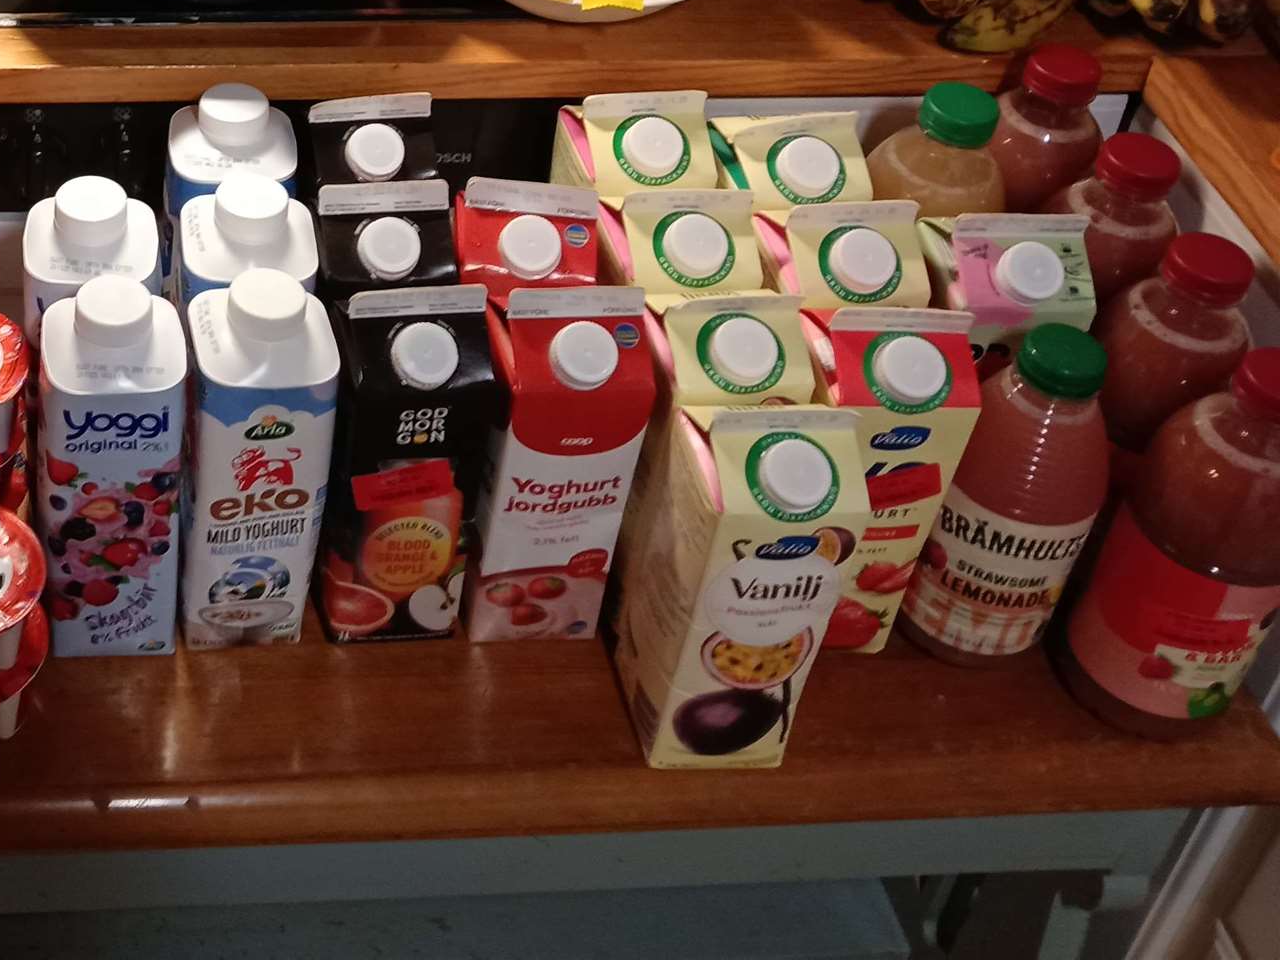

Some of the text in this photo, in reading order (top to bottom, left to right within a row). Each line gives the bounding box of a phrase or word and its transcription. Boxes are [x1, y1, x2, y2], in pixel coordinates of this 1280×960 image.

[63, 406, 170, 440] yoggi
[400, 407, 449, 421] GOD
[251, 423, 288, 438] Arla
[398, 418, 445, 433] MOR
[64, 439, 138, 454] original
[873, 433, 922, 445] Valio
[511, 474, 624, 500] Yoghurt
[210, 488, 310, 521] eko
[207, 525, 241, 545] MILD
[244, 517, 308, 541] YOGHURT
[758, 542, 812, 556] Valio
[731, 574, 824, 601] Vanilj
[940, 570, 1049, 608] LEMONADE
